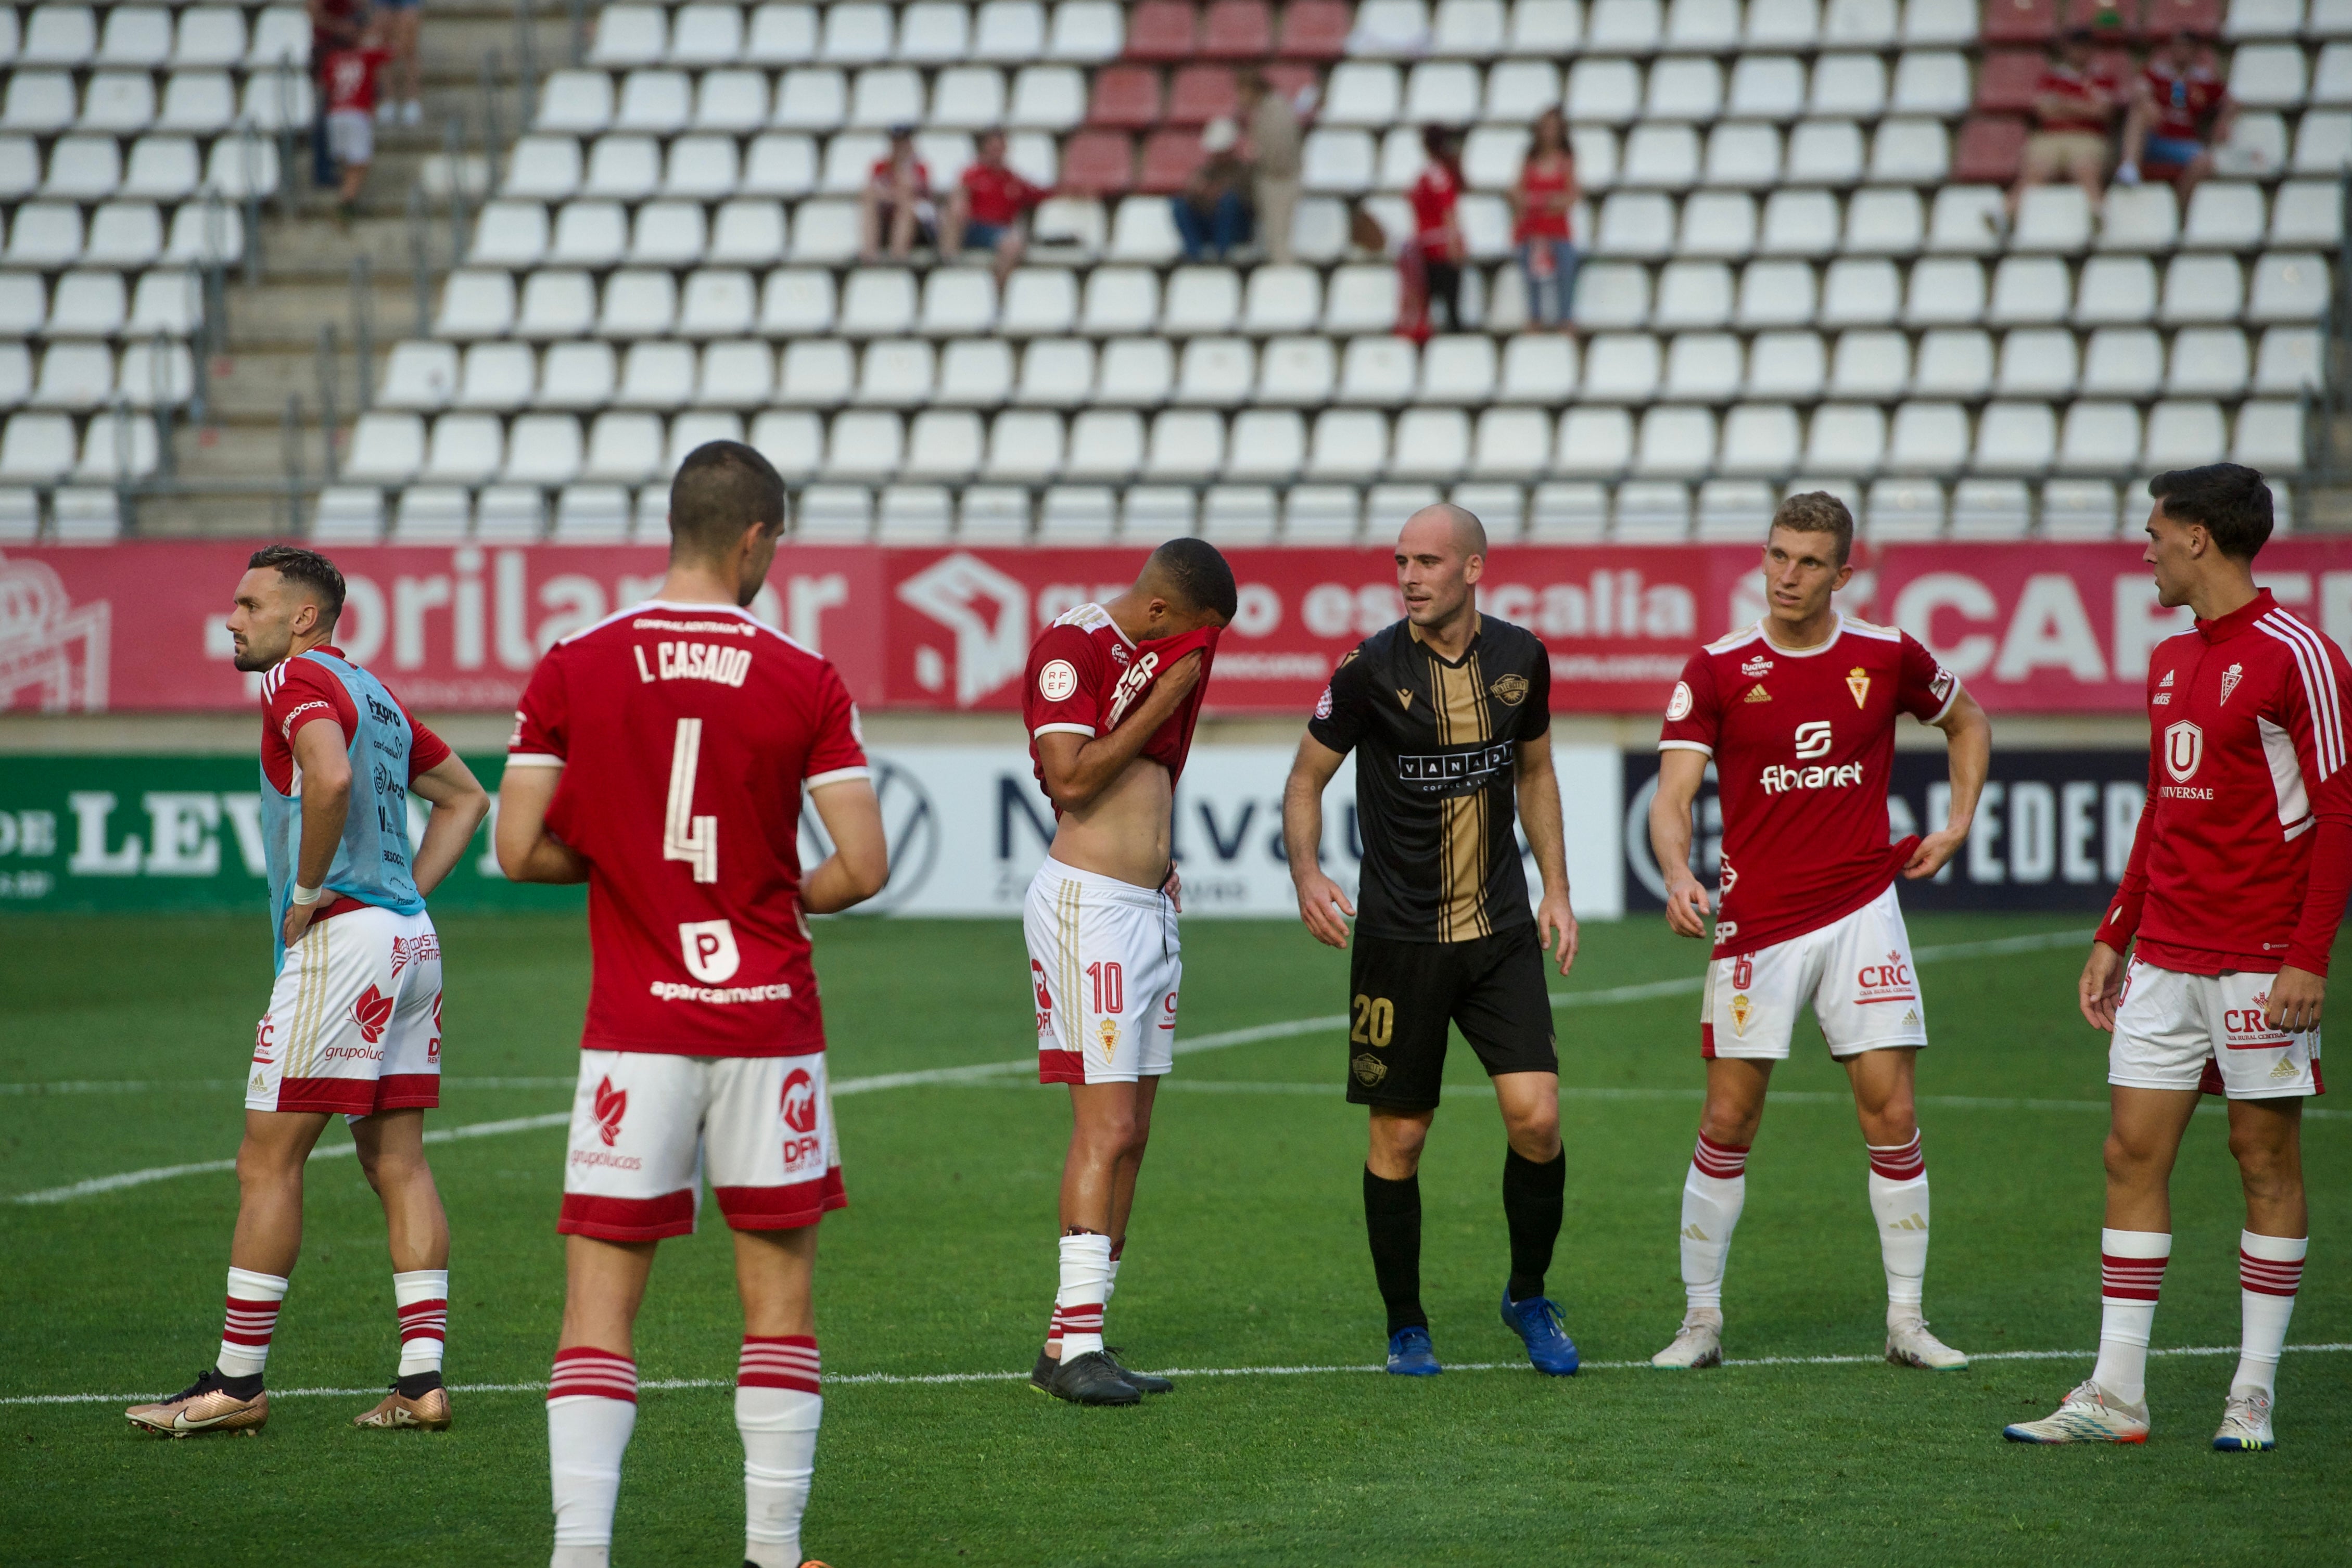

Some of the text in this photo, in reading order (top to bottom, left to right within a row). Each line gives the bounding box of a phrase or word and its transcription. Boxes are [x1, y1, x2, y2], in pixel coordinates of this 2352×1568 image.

[657, 641, 753, 688] CASADO
[664, 718, 718, 883] 4
[1760, 761, 1863, 795] fibranet
[1086, 961, 1123, 1014] 10
[1858, 964, 1911, 988] CRC
[1352, 993, 1394, 1047] 20
[2269, 1070, 2300, 1078] adidas
